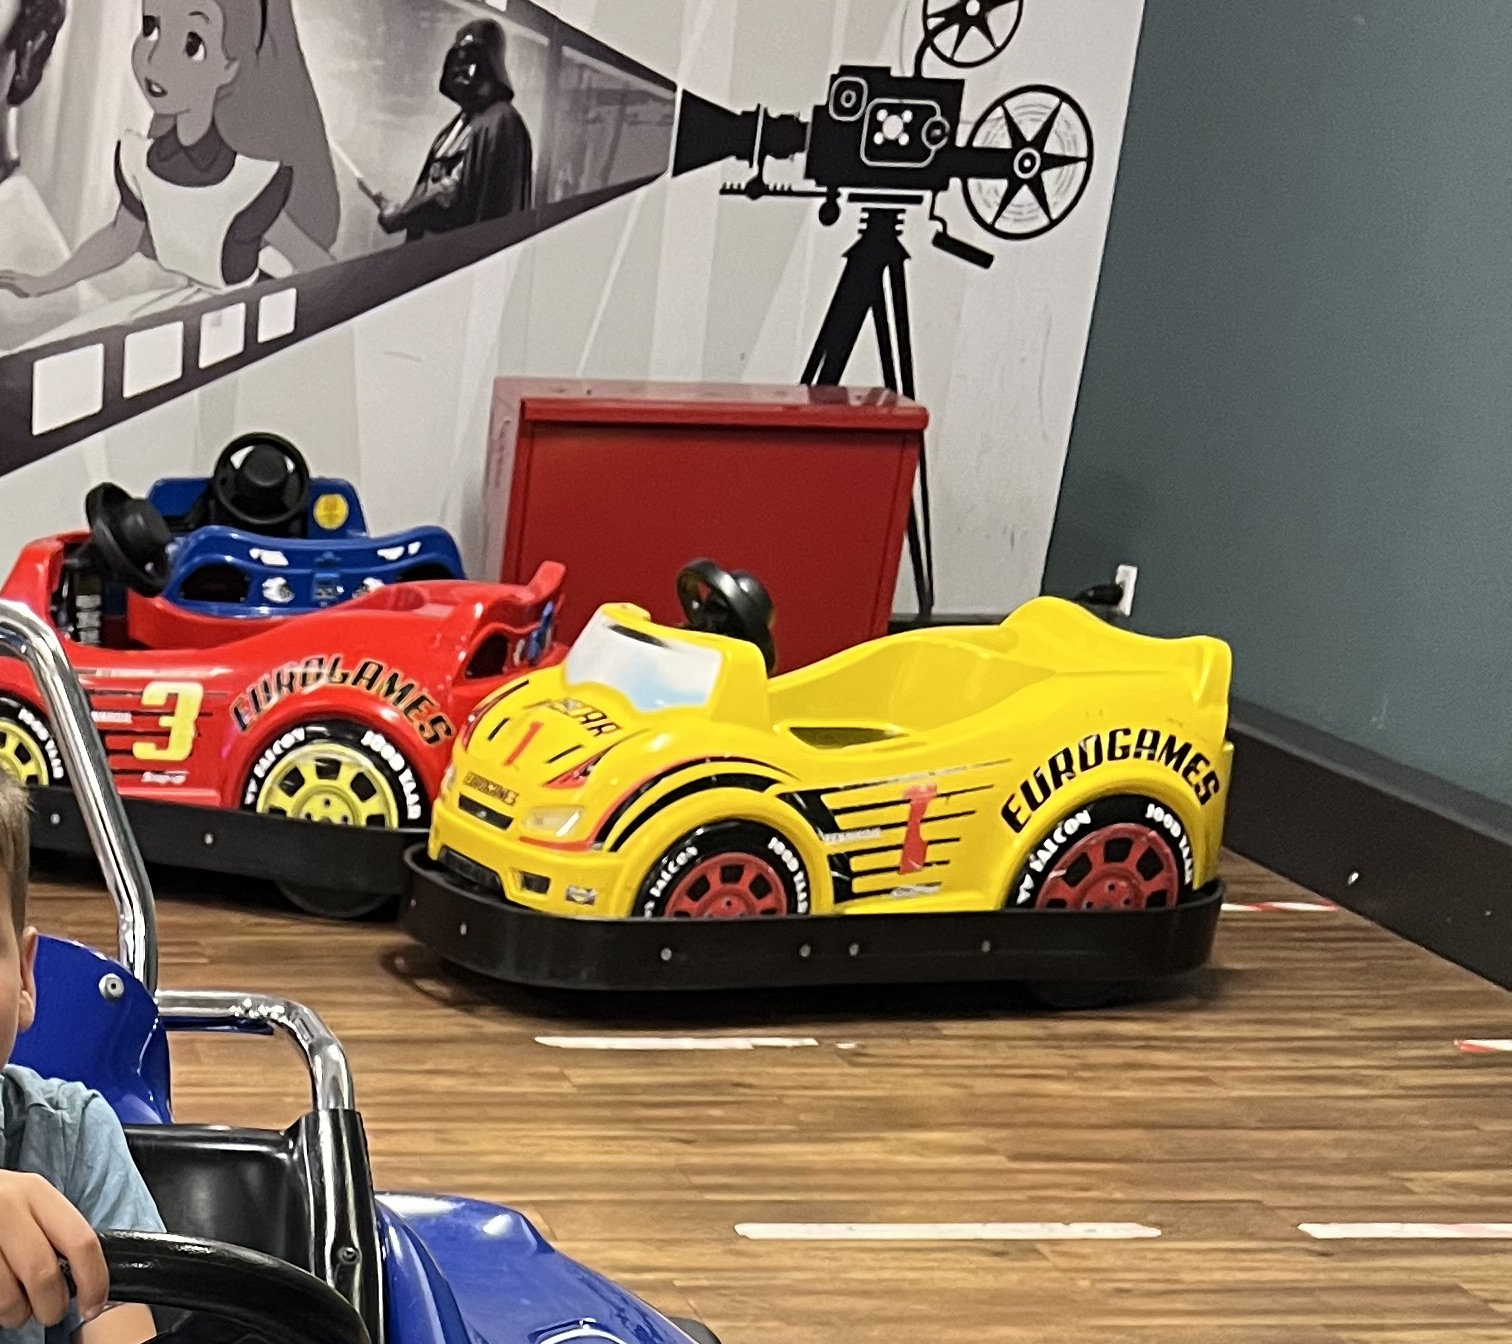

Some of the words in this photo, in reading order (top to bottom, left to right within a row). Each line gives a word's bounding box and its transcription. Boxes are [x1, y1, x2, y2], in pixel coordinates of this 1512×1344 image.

[133, 682, 205, 762] 3
[232, 655, 455, 746] EUROGAMES
[1001, 728, 1220, 833] EUROGAMES
